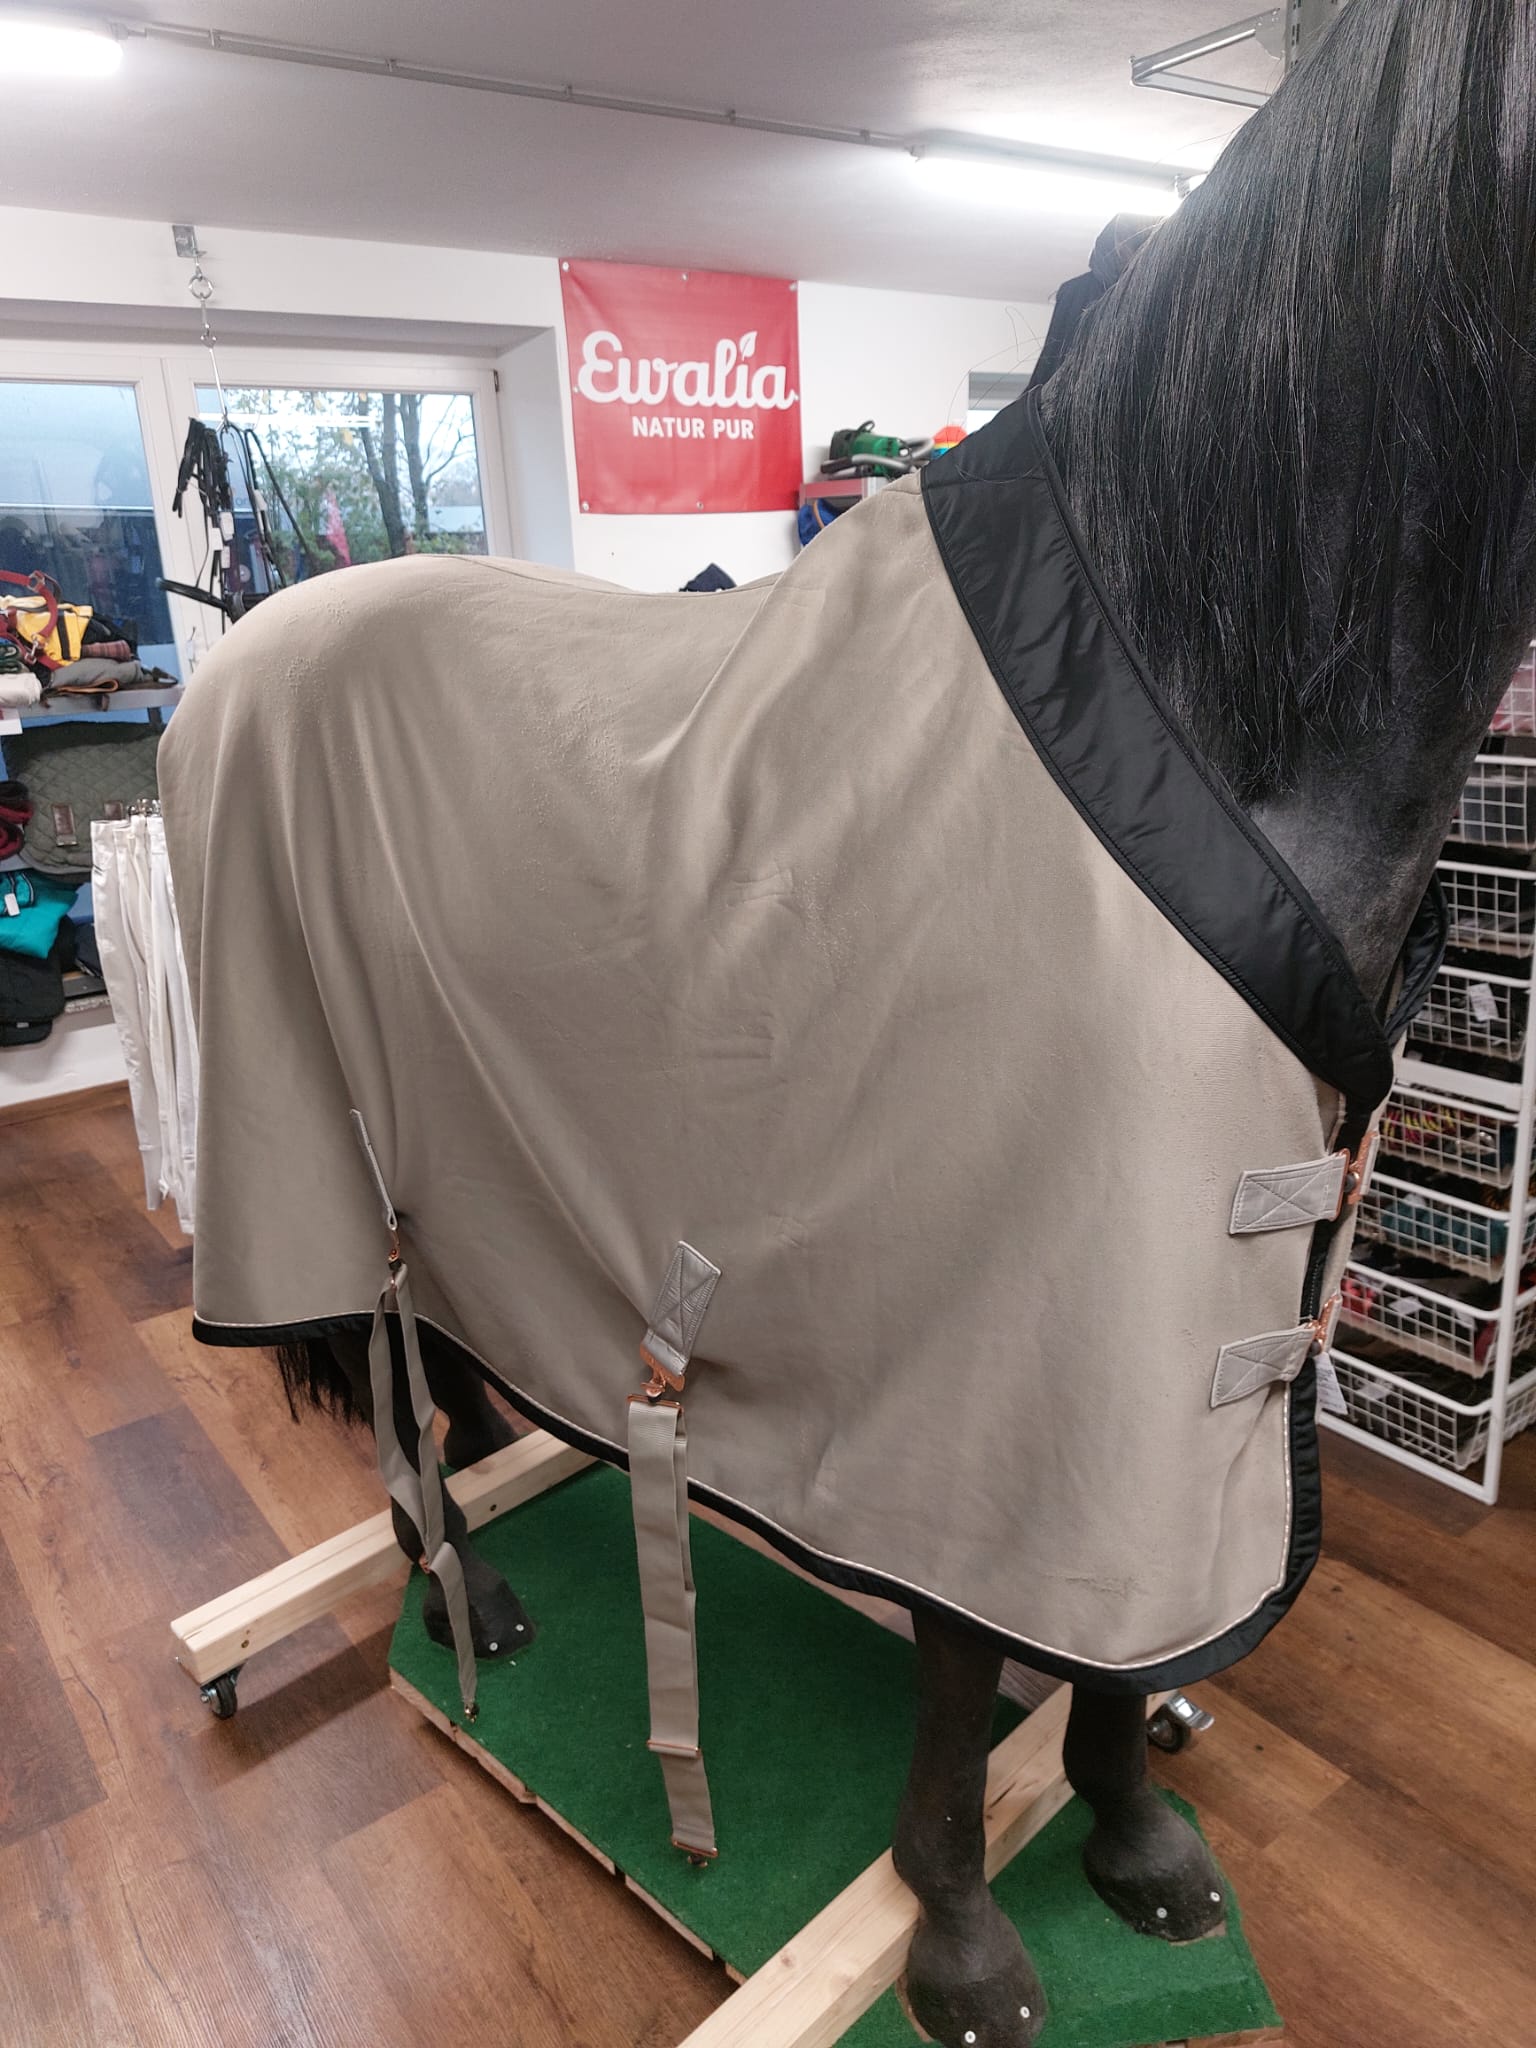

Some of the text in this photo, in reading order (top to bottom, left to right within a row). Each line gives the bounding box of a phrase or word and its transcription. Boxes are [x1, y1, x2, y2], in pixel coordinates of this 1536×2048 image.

[578, 331, 796, 409] Ewalia
[632, 416, 754, 439] NATUR PUR
